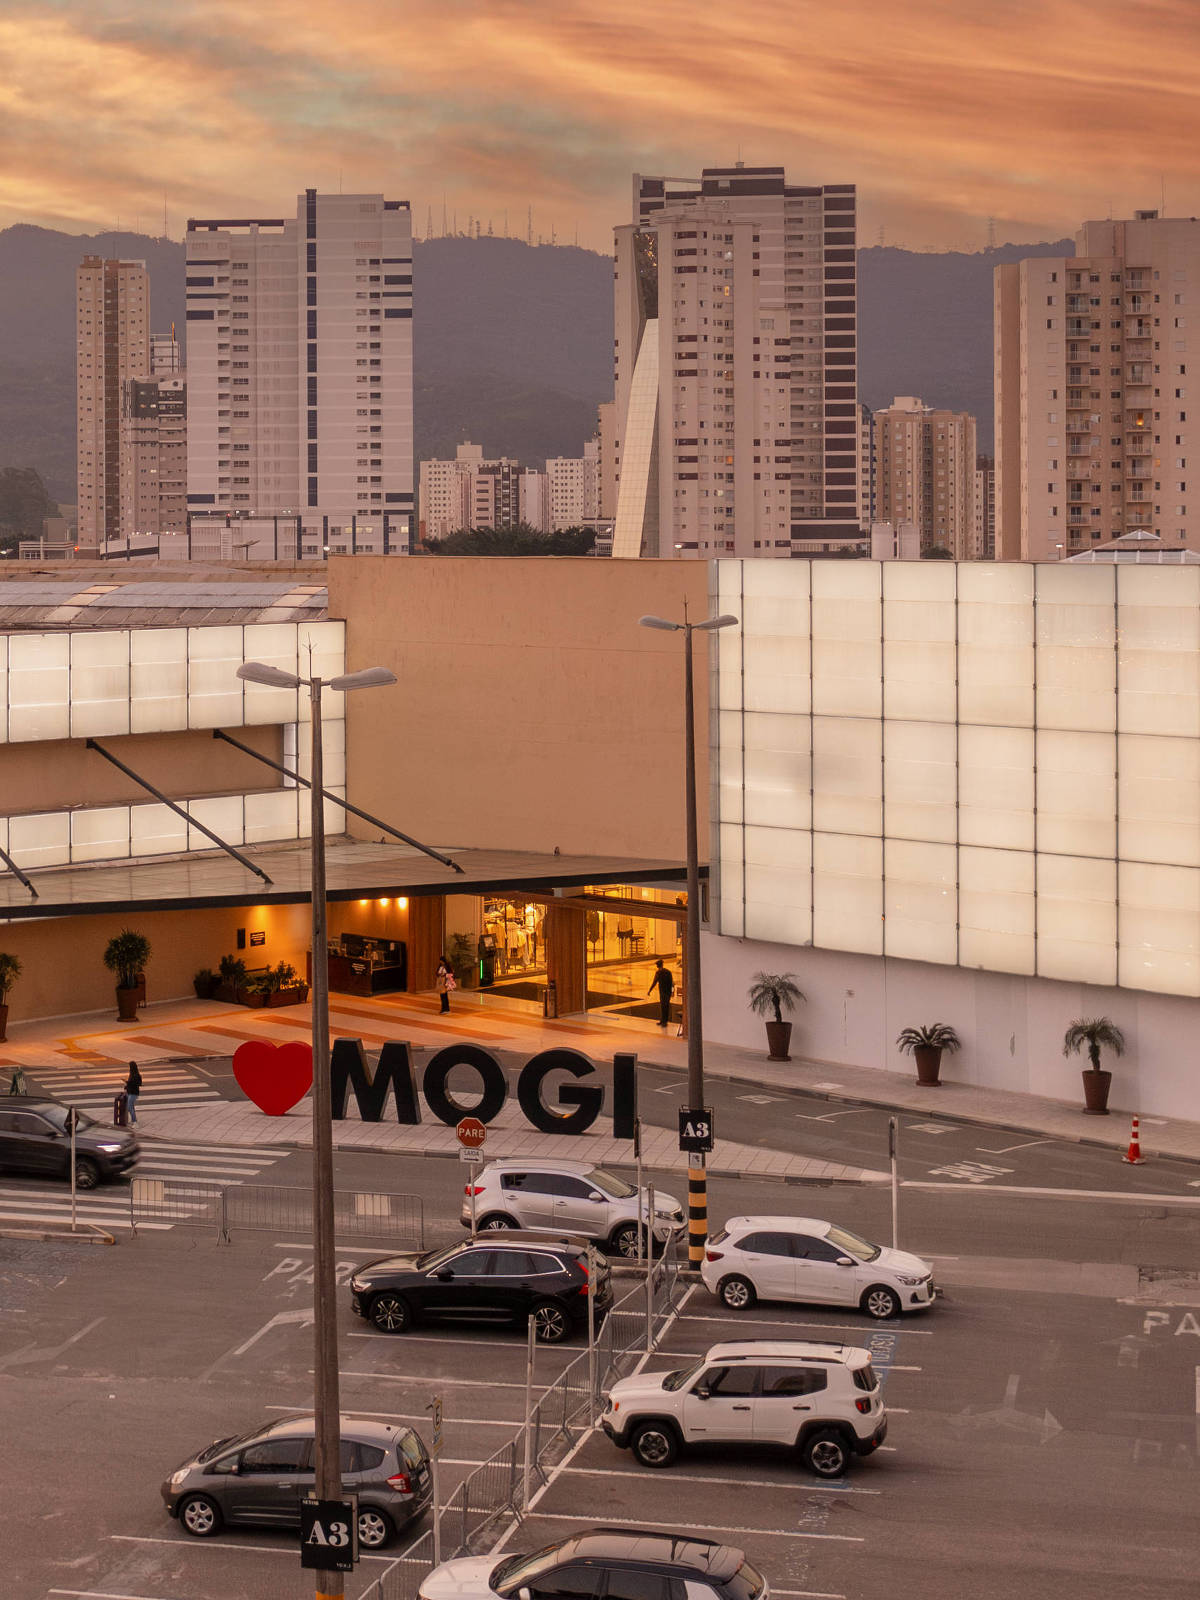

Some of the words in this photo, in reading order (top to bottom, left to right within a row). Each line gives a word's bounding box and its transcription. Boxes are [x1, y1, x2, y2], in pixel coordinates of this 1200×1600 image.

[330, 1037, 638, 1140] MOGI
[458, 1127, 485, 1139] PARE
[680, 1121, 710, 1138] A3
[303, 1519, 350, 1547] A3
